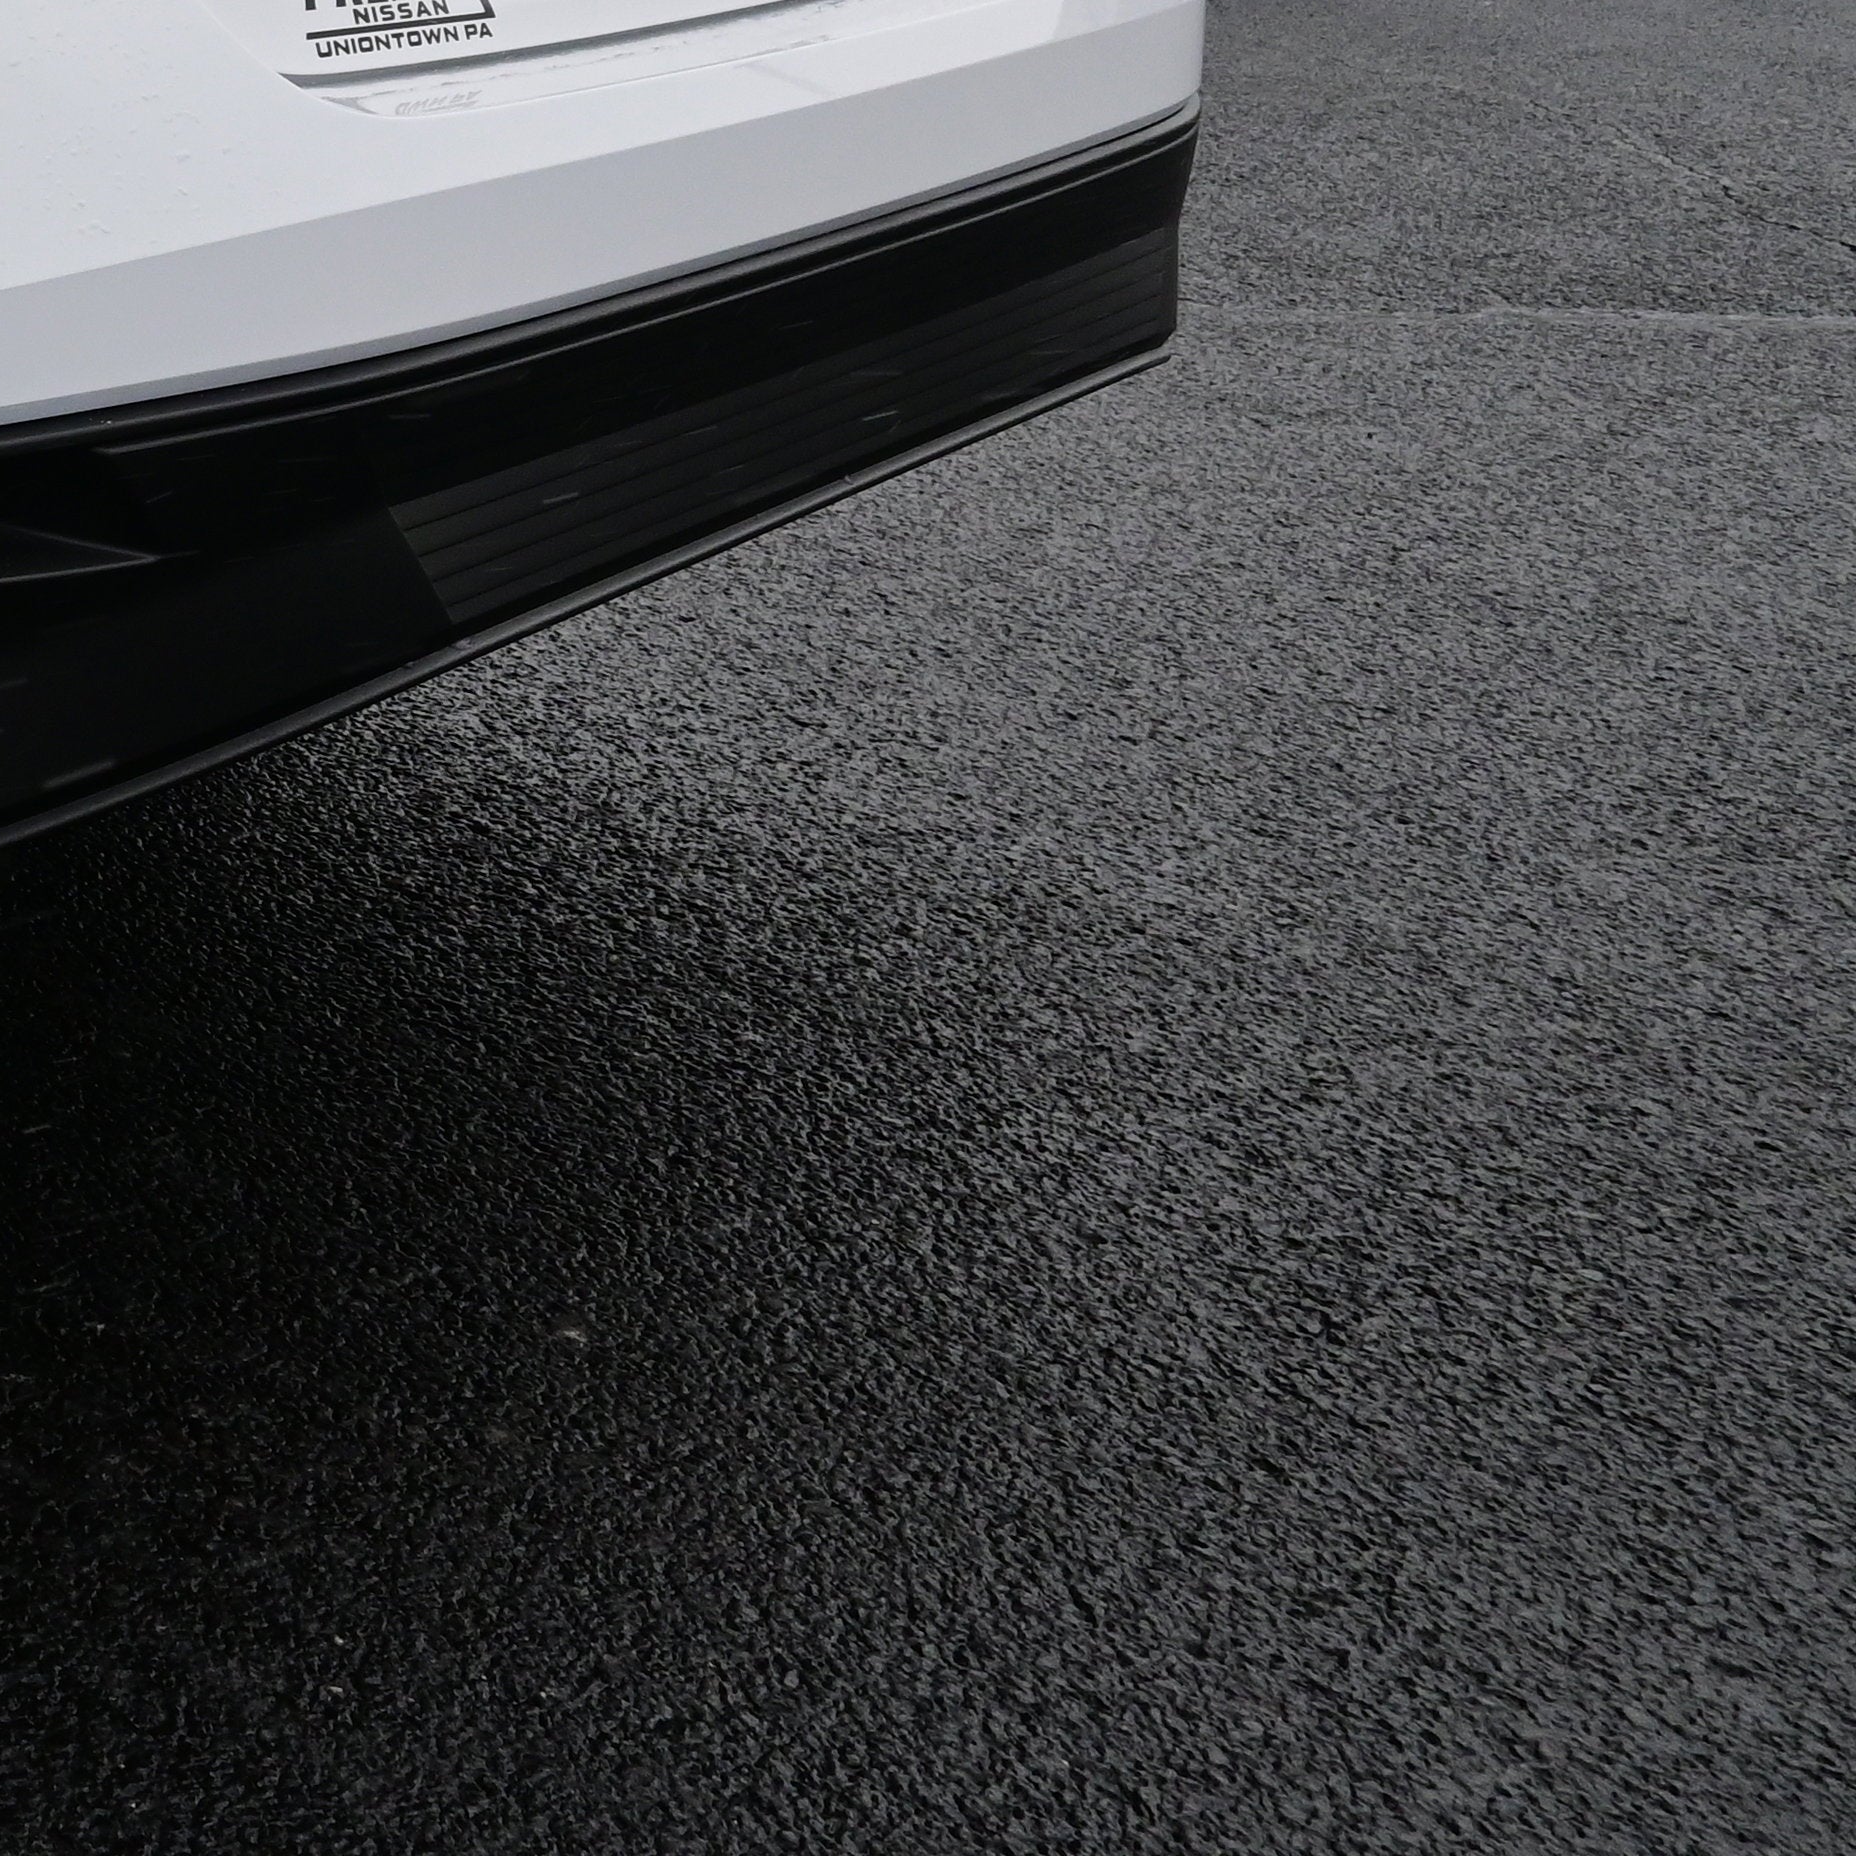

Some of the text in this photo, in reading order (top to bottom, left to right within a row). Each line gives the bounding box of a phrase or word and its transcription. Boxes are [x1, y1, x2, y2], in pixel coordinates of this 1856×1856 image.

[353, 0, 449, 24] NISSAN
[315, 23, 493, 58] UNIONTOWN PA
